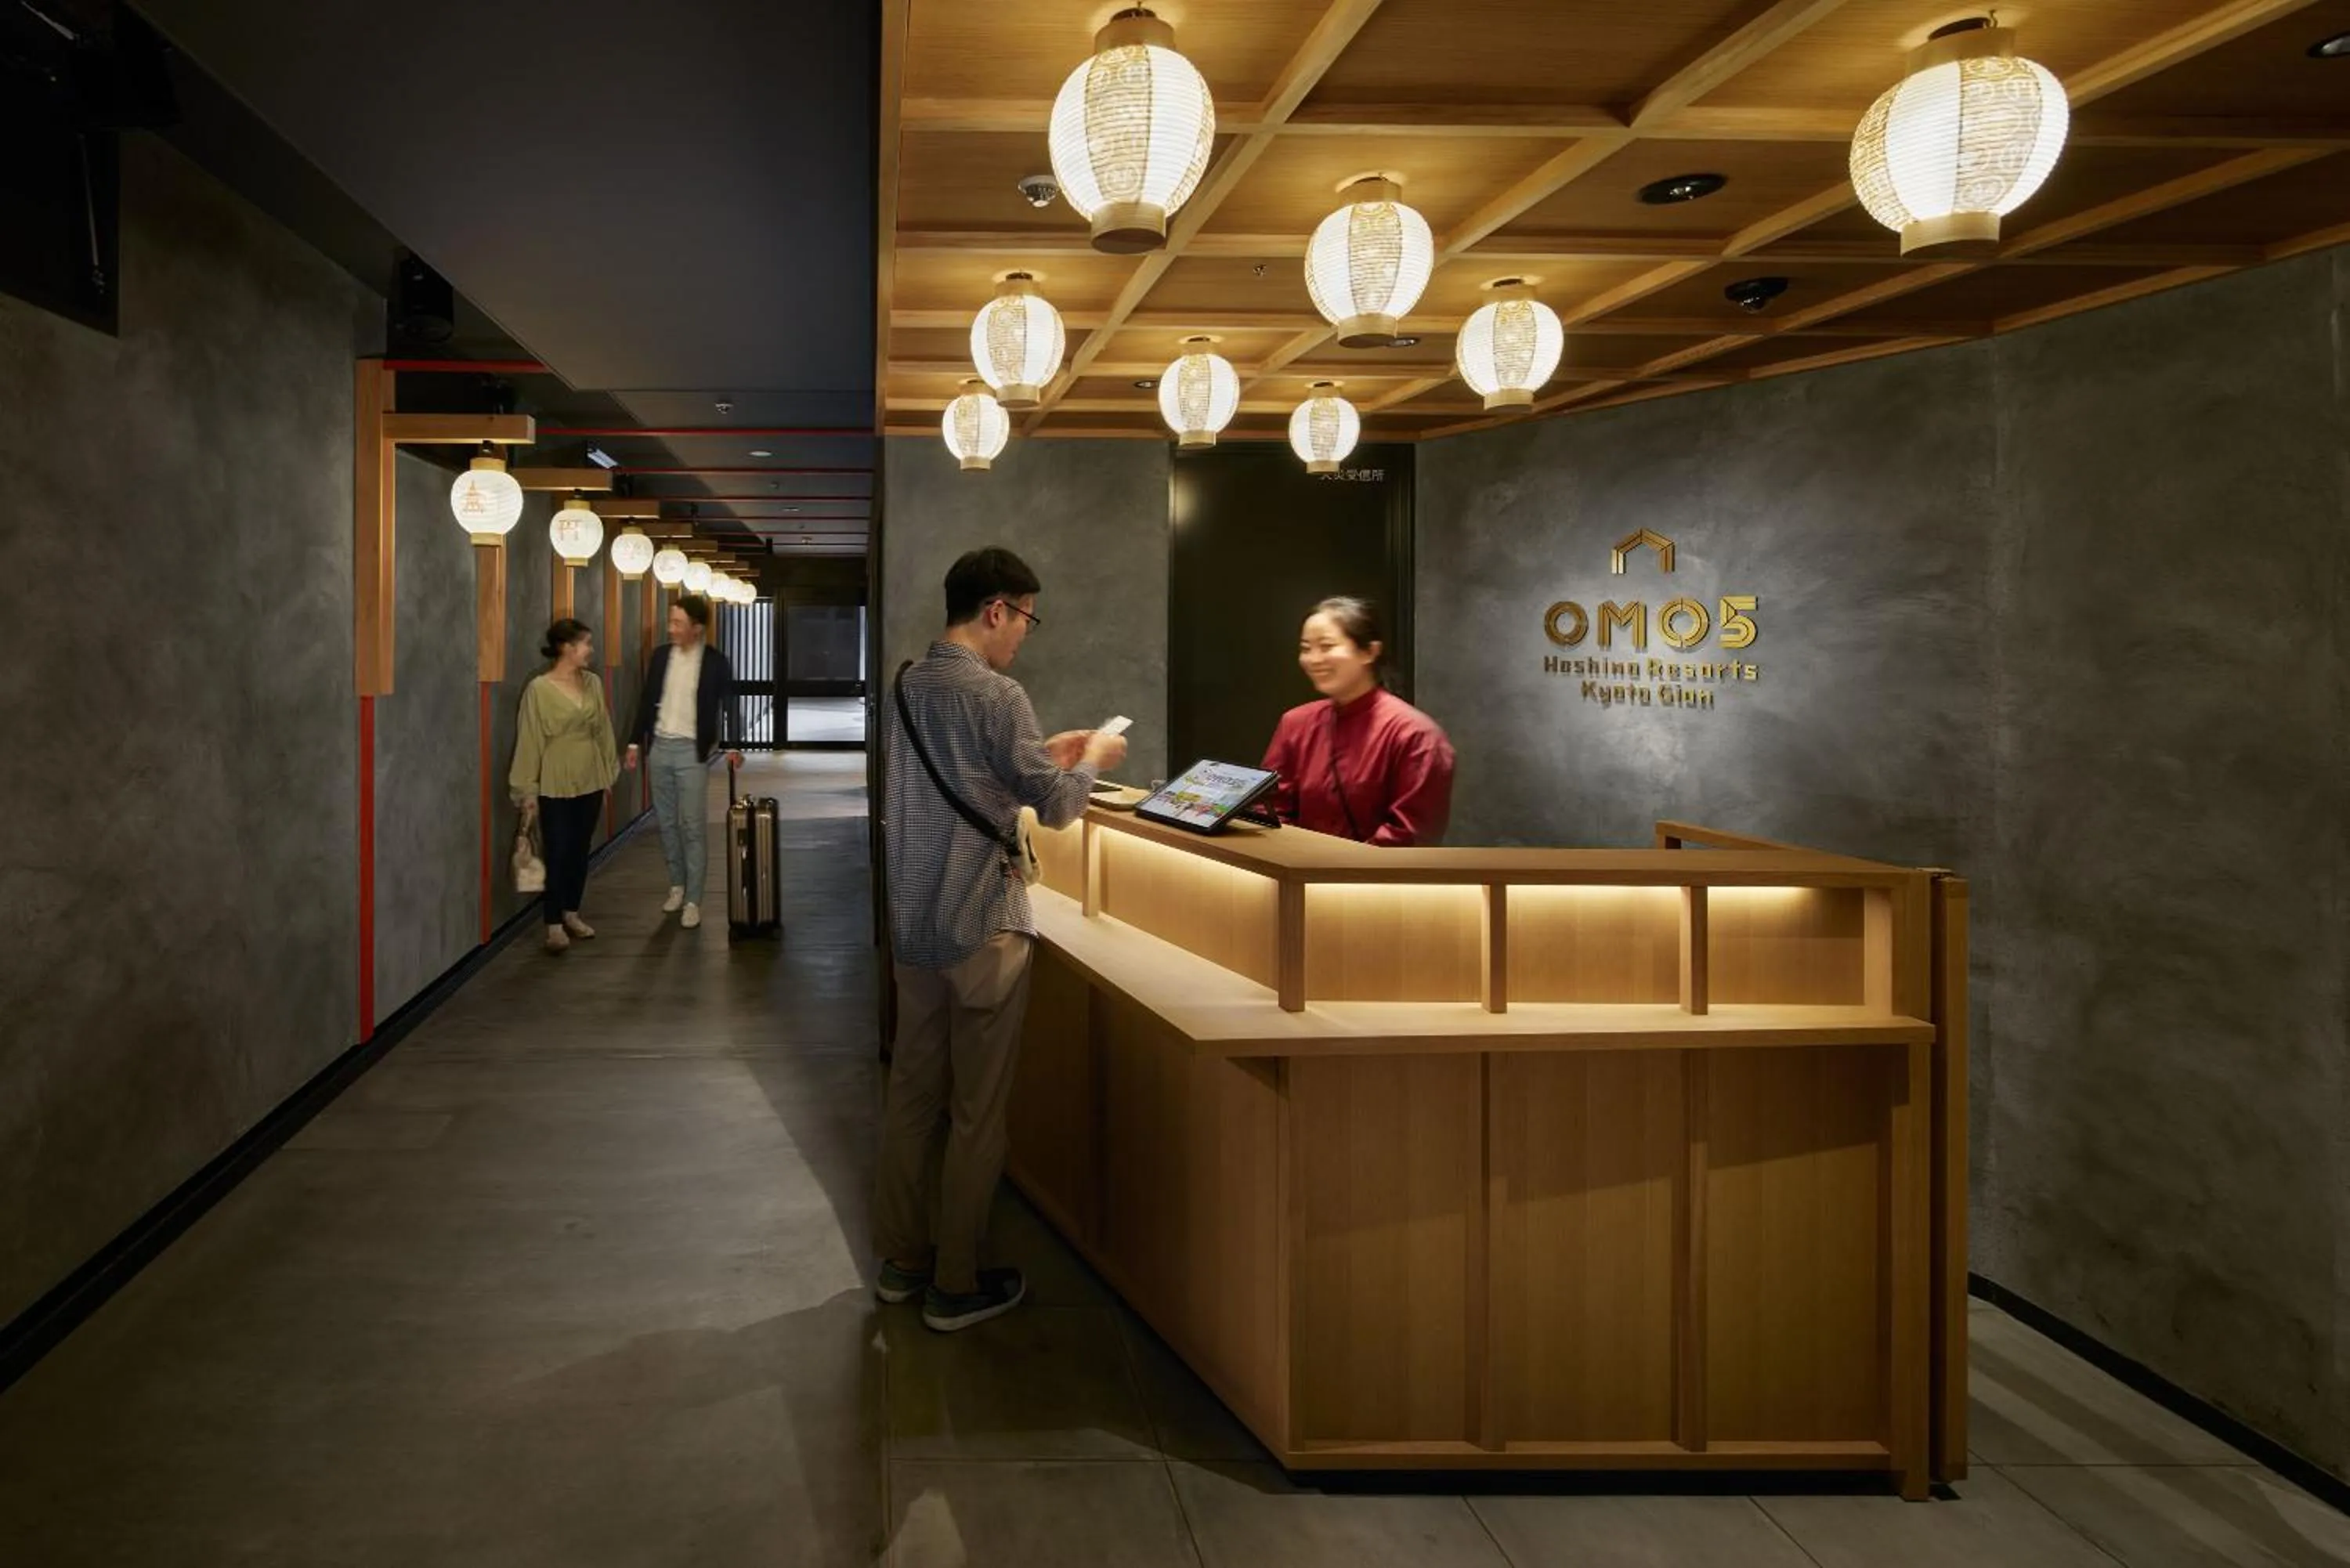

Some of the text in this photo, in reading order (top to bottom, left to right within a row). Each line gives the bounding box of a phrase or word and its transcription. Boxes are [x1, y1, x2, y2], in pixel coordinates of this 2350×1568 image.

[1544, 595, 1759, 649] OMO5
[1544, 656, 1759, 681] Hoshino Resorts
[1582, 681, 1716, 709] Kyoto Gion
